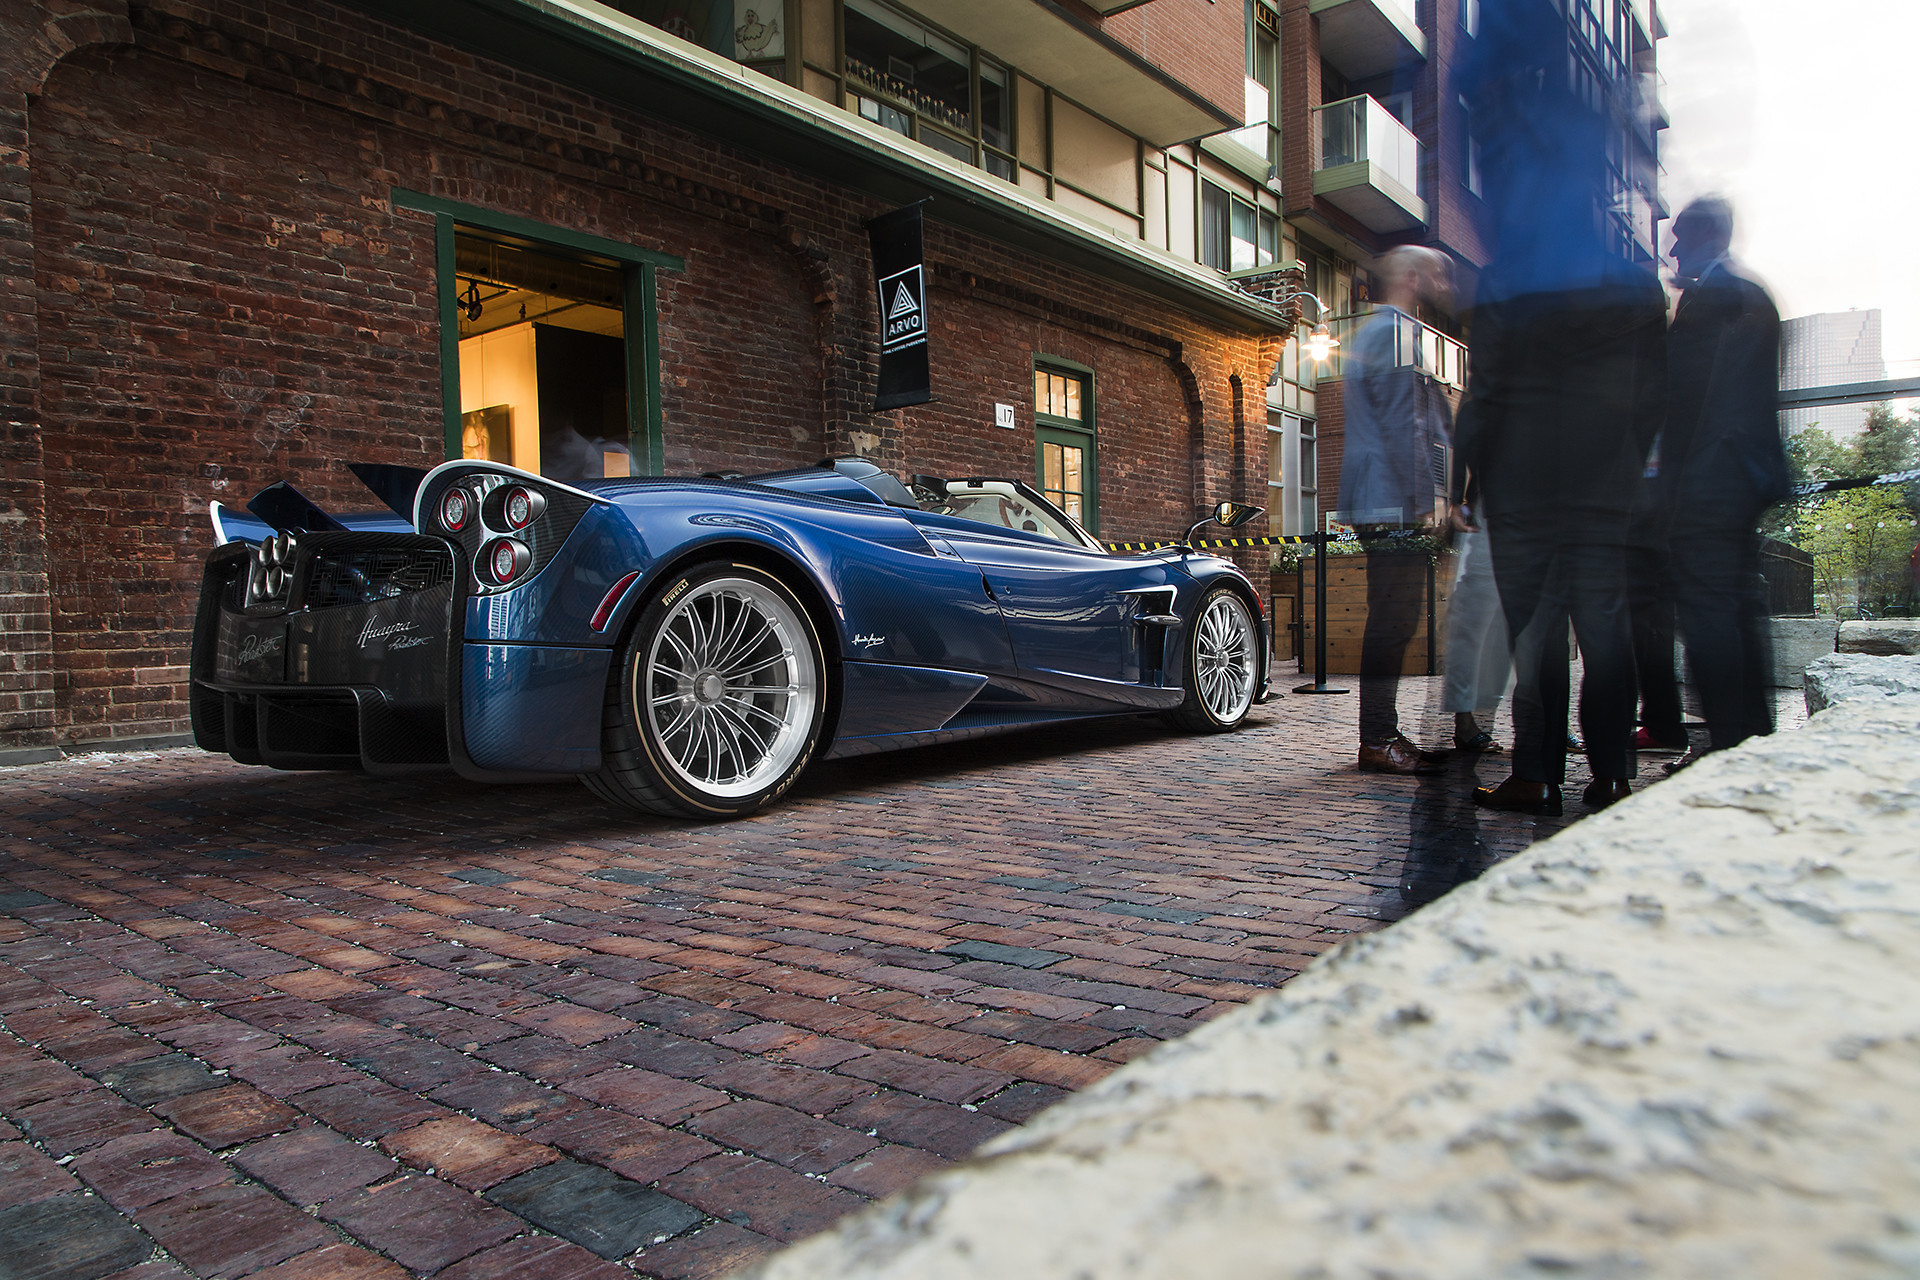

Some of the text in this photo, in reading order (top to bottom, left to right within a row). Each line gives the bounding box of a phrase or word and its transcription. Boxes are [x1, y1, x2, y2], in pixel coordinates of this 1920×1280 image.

[888, 314, 920, 336] ARVO
[1004, 409, 1012, 423] 17
[354, 615, 420, 648] Huayra
